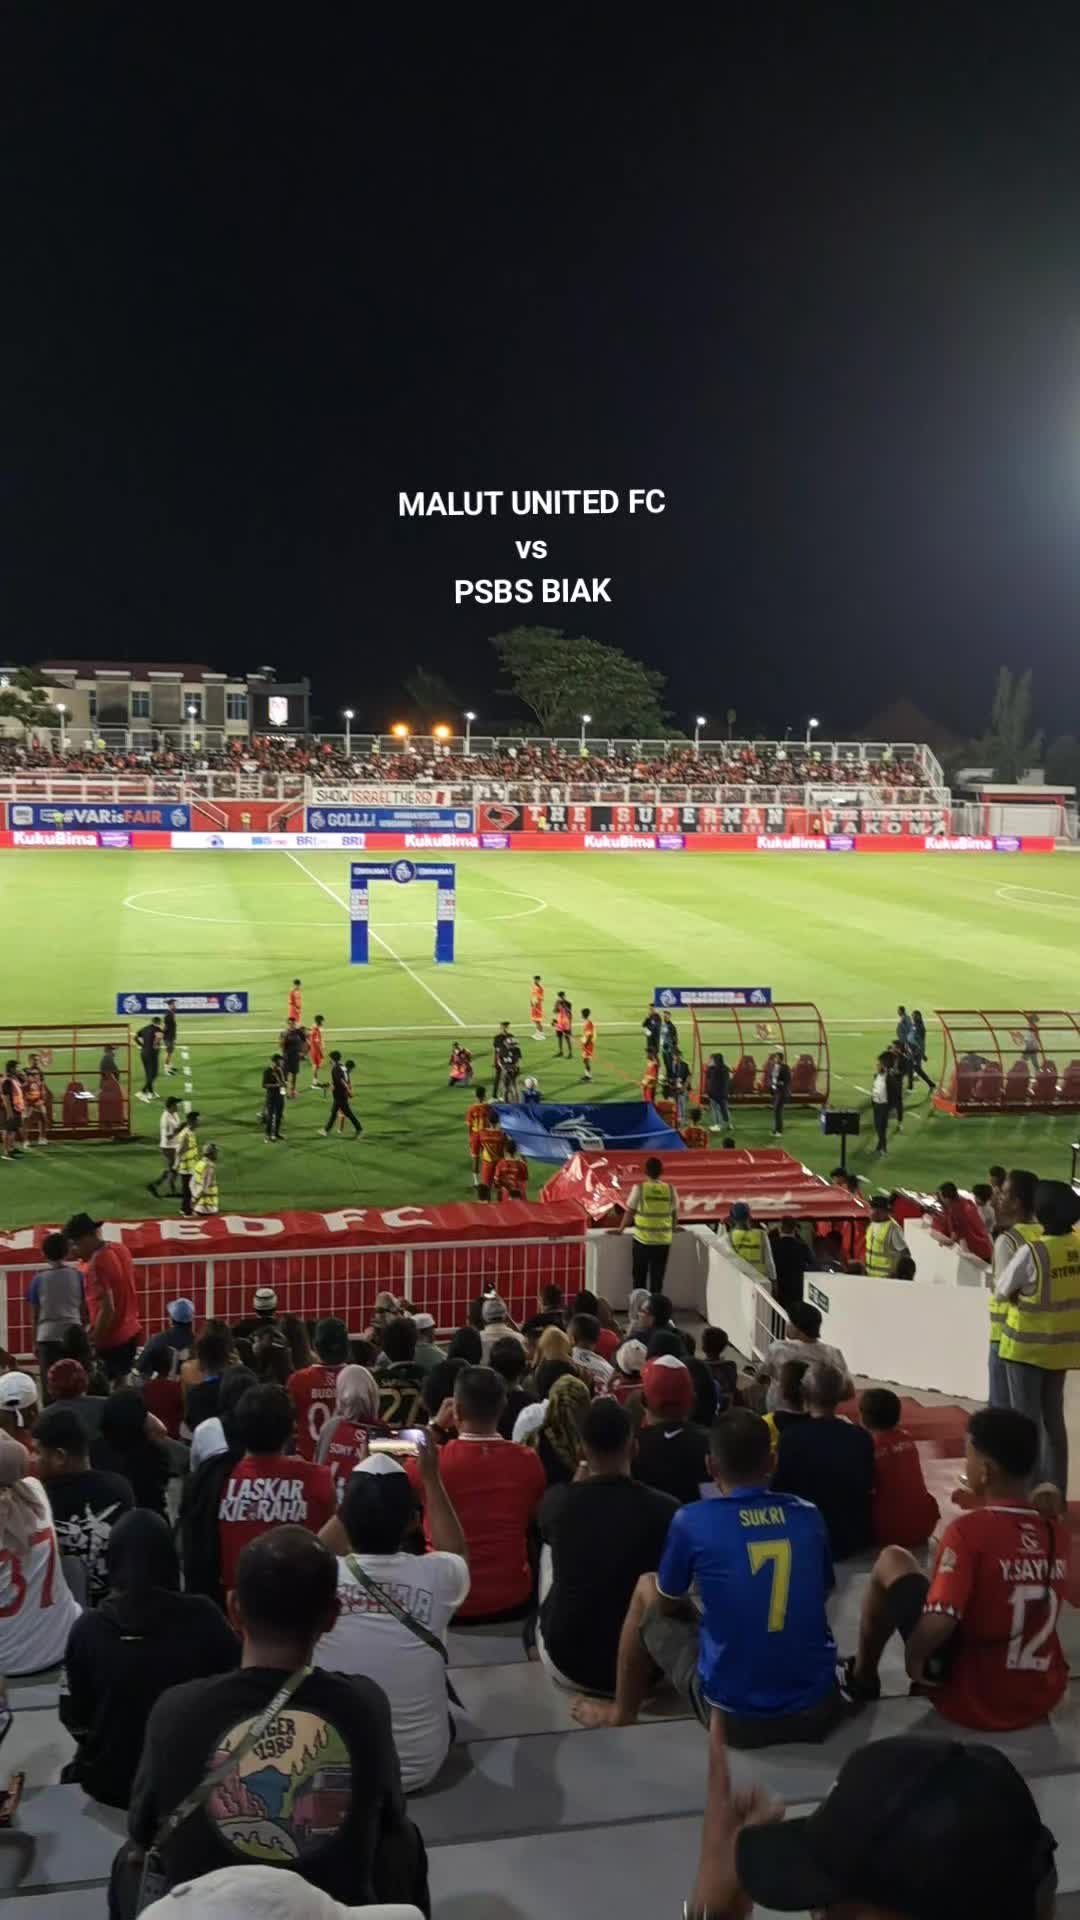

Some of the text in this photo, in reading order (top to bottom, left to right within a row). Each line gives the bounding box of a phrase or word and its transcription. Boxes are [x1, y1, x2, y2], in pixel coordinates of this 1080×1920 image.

[617, 806, 784, 825] SUPERMAN
[320, 1206, 433, 1233] FC
[228, 1477, 304, 1501] LASKAR
[739, 1506, 786, 1528] SUKRI
[747, 1538, 792, 1633] 7
[1006, 1584, 1059, 1672] 12
